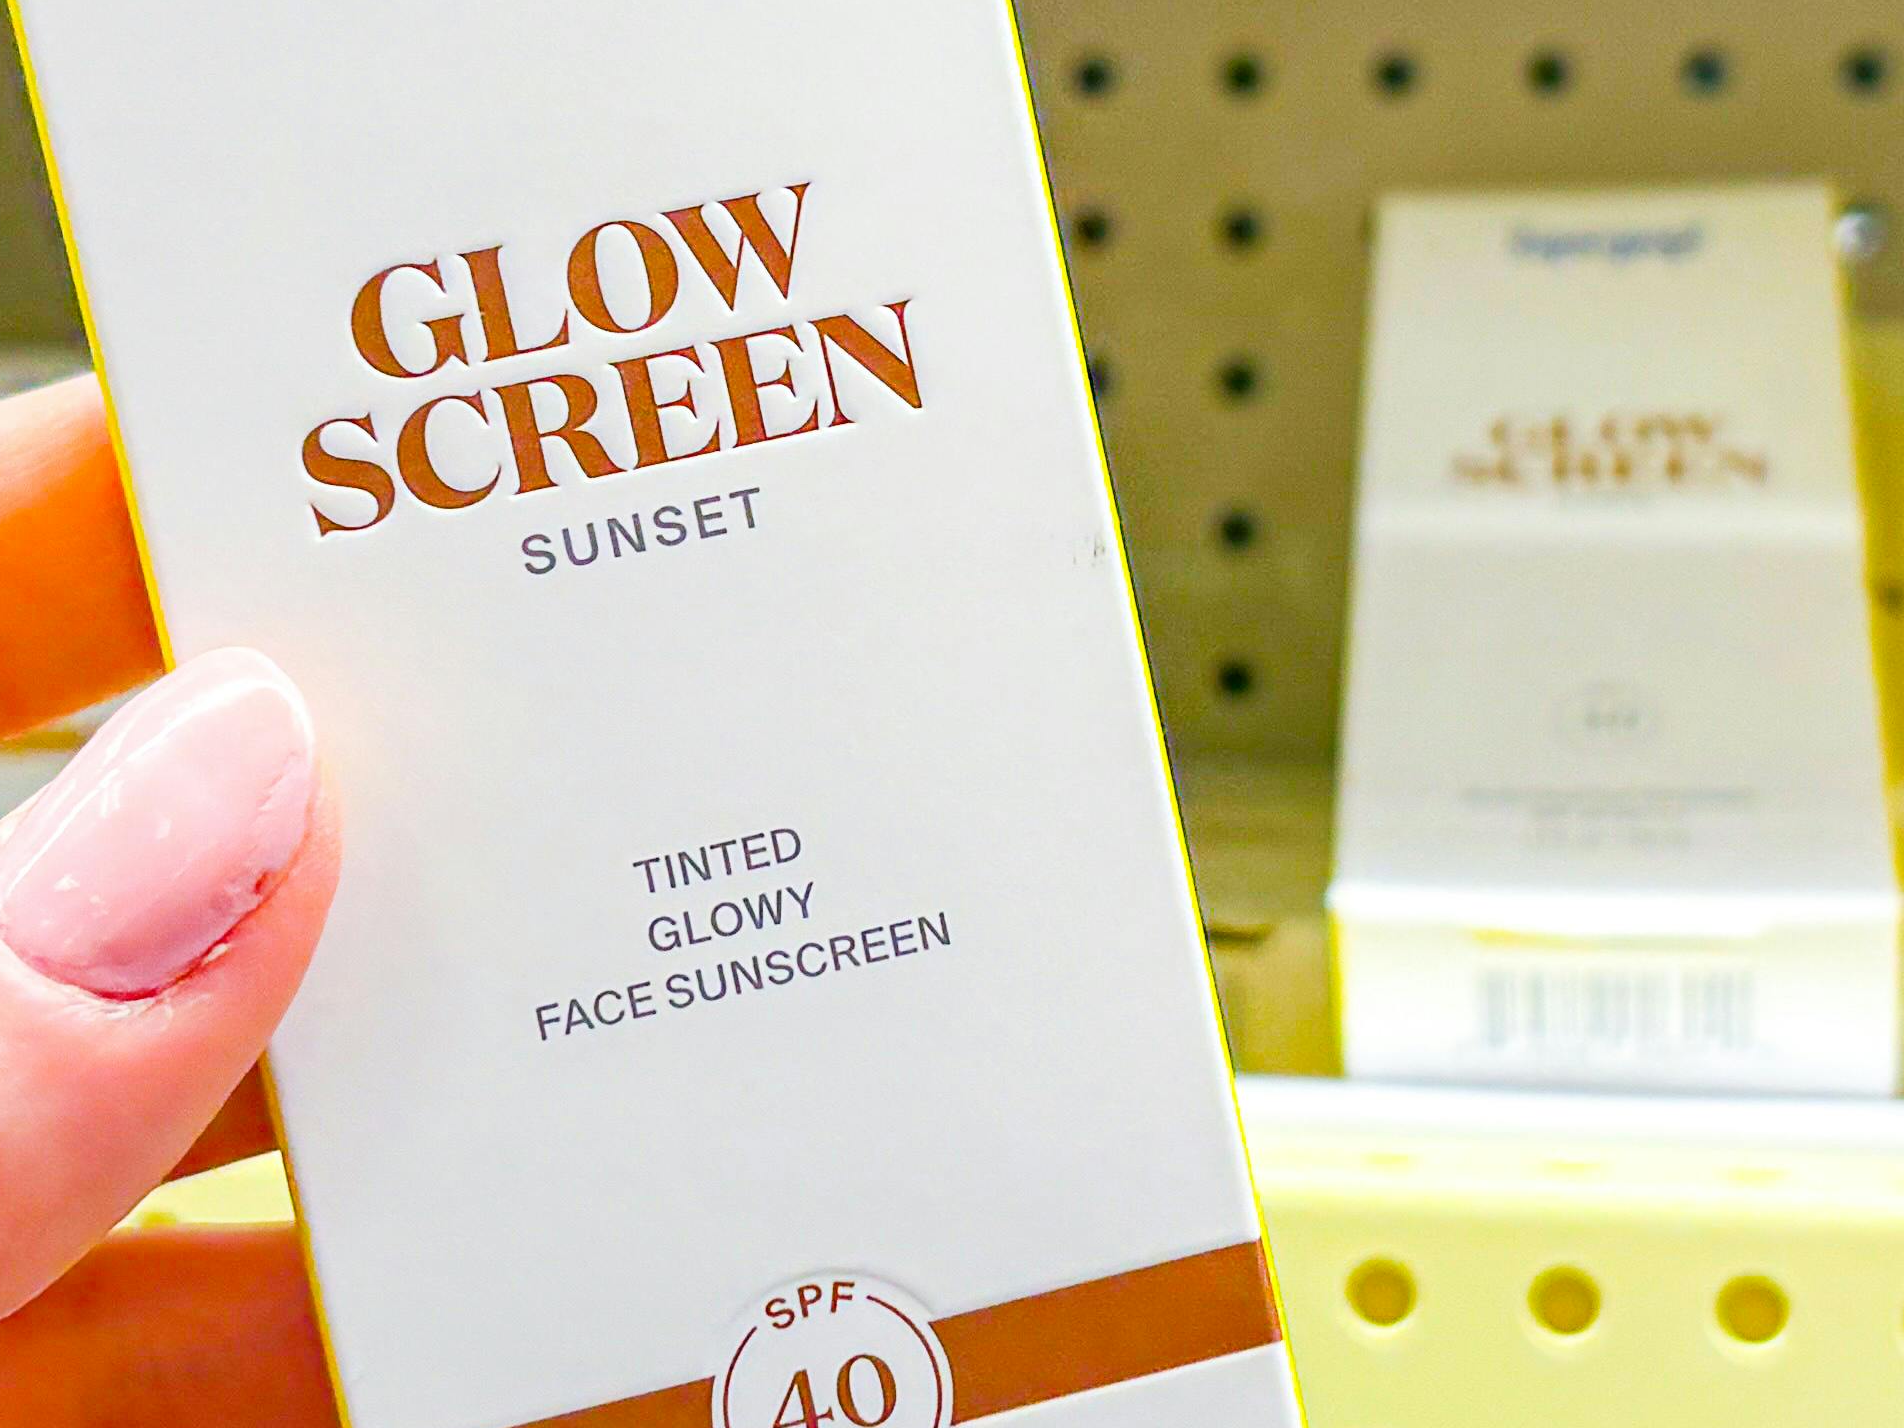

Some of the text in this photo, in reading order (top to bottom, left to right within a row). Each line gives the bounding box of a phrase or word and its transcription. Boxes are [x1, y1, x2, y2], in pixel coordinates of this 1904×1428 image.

[350, 182, 811, 379] GLOW
[301, 298, 922, 537] SCREEN
[520, 487, 761, 575] SUNSET
[632, 827, 802, 894] TINTED
[647, 881, 815, 952] GLOWY
[535, 911, 952, 1041] FACE SUNSCREEN
[764, 1281, 855, 1330] SPF
